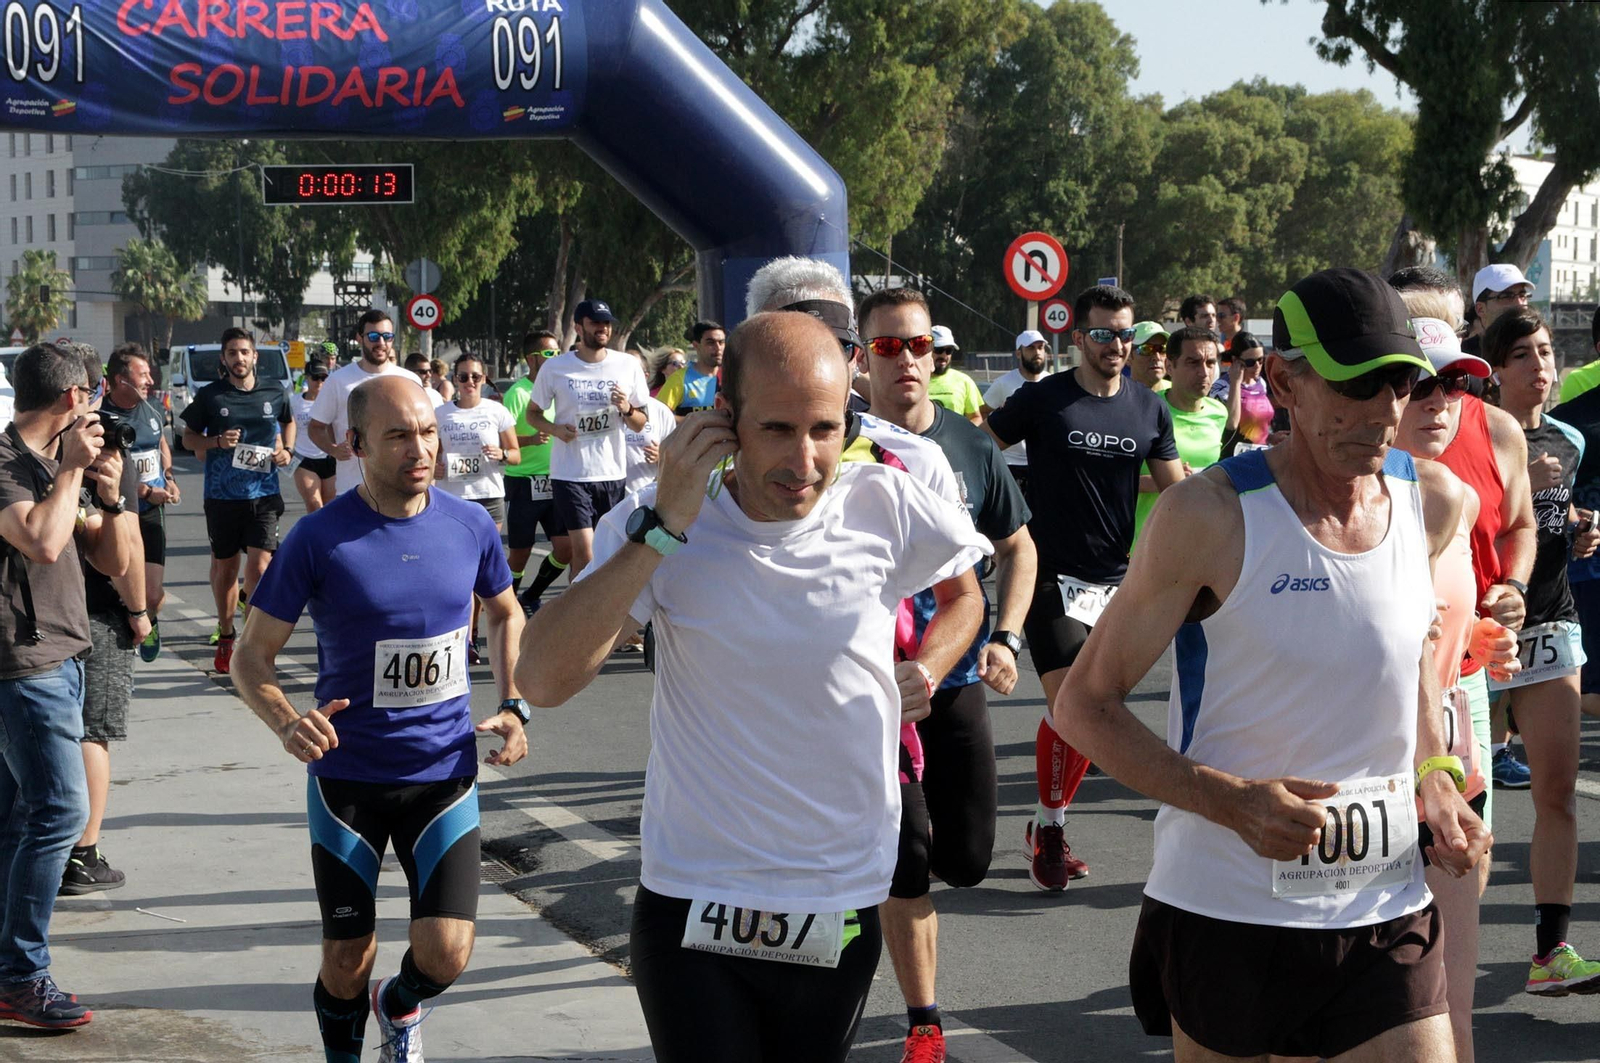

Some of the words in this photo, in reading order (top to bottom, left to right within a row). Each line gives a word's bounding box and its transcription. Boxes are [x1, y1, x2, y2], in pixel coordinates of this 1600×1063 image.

[116, 0, 389, 42] CARRERA
[5, 2, 83, 82] 091
[493, 16, 561, 90] 091
[168, 62, 465, 108] SOLIDARIA
[299, 173, 396, 197] 0:00:13
[414, 306, 436, 318] 40
[1048, 310, 1067, 321] 40
[578, 413, 610, 433] 4262
[1068, 430, 1137, 453] COPO
[133, 456, 154, 474] 009
[237, 449, 267, 469] 4258
[451, 458, 480, 474] 4288
[1290, 577, 1330, 591] asics
[383, 646, 451, 689] 4061
[1301, 800, 1389, 866] 001
[1279, 863, 1347, 881] AGRUPACIÓN
[1349, 860, 1402, 875] DEPORTIVA
[1334, 880, 1351, 890] 4001
[690, 941, 759, 957] AGRUPACIÓN
[761, 949, 821, 965] DEPORTIVA
